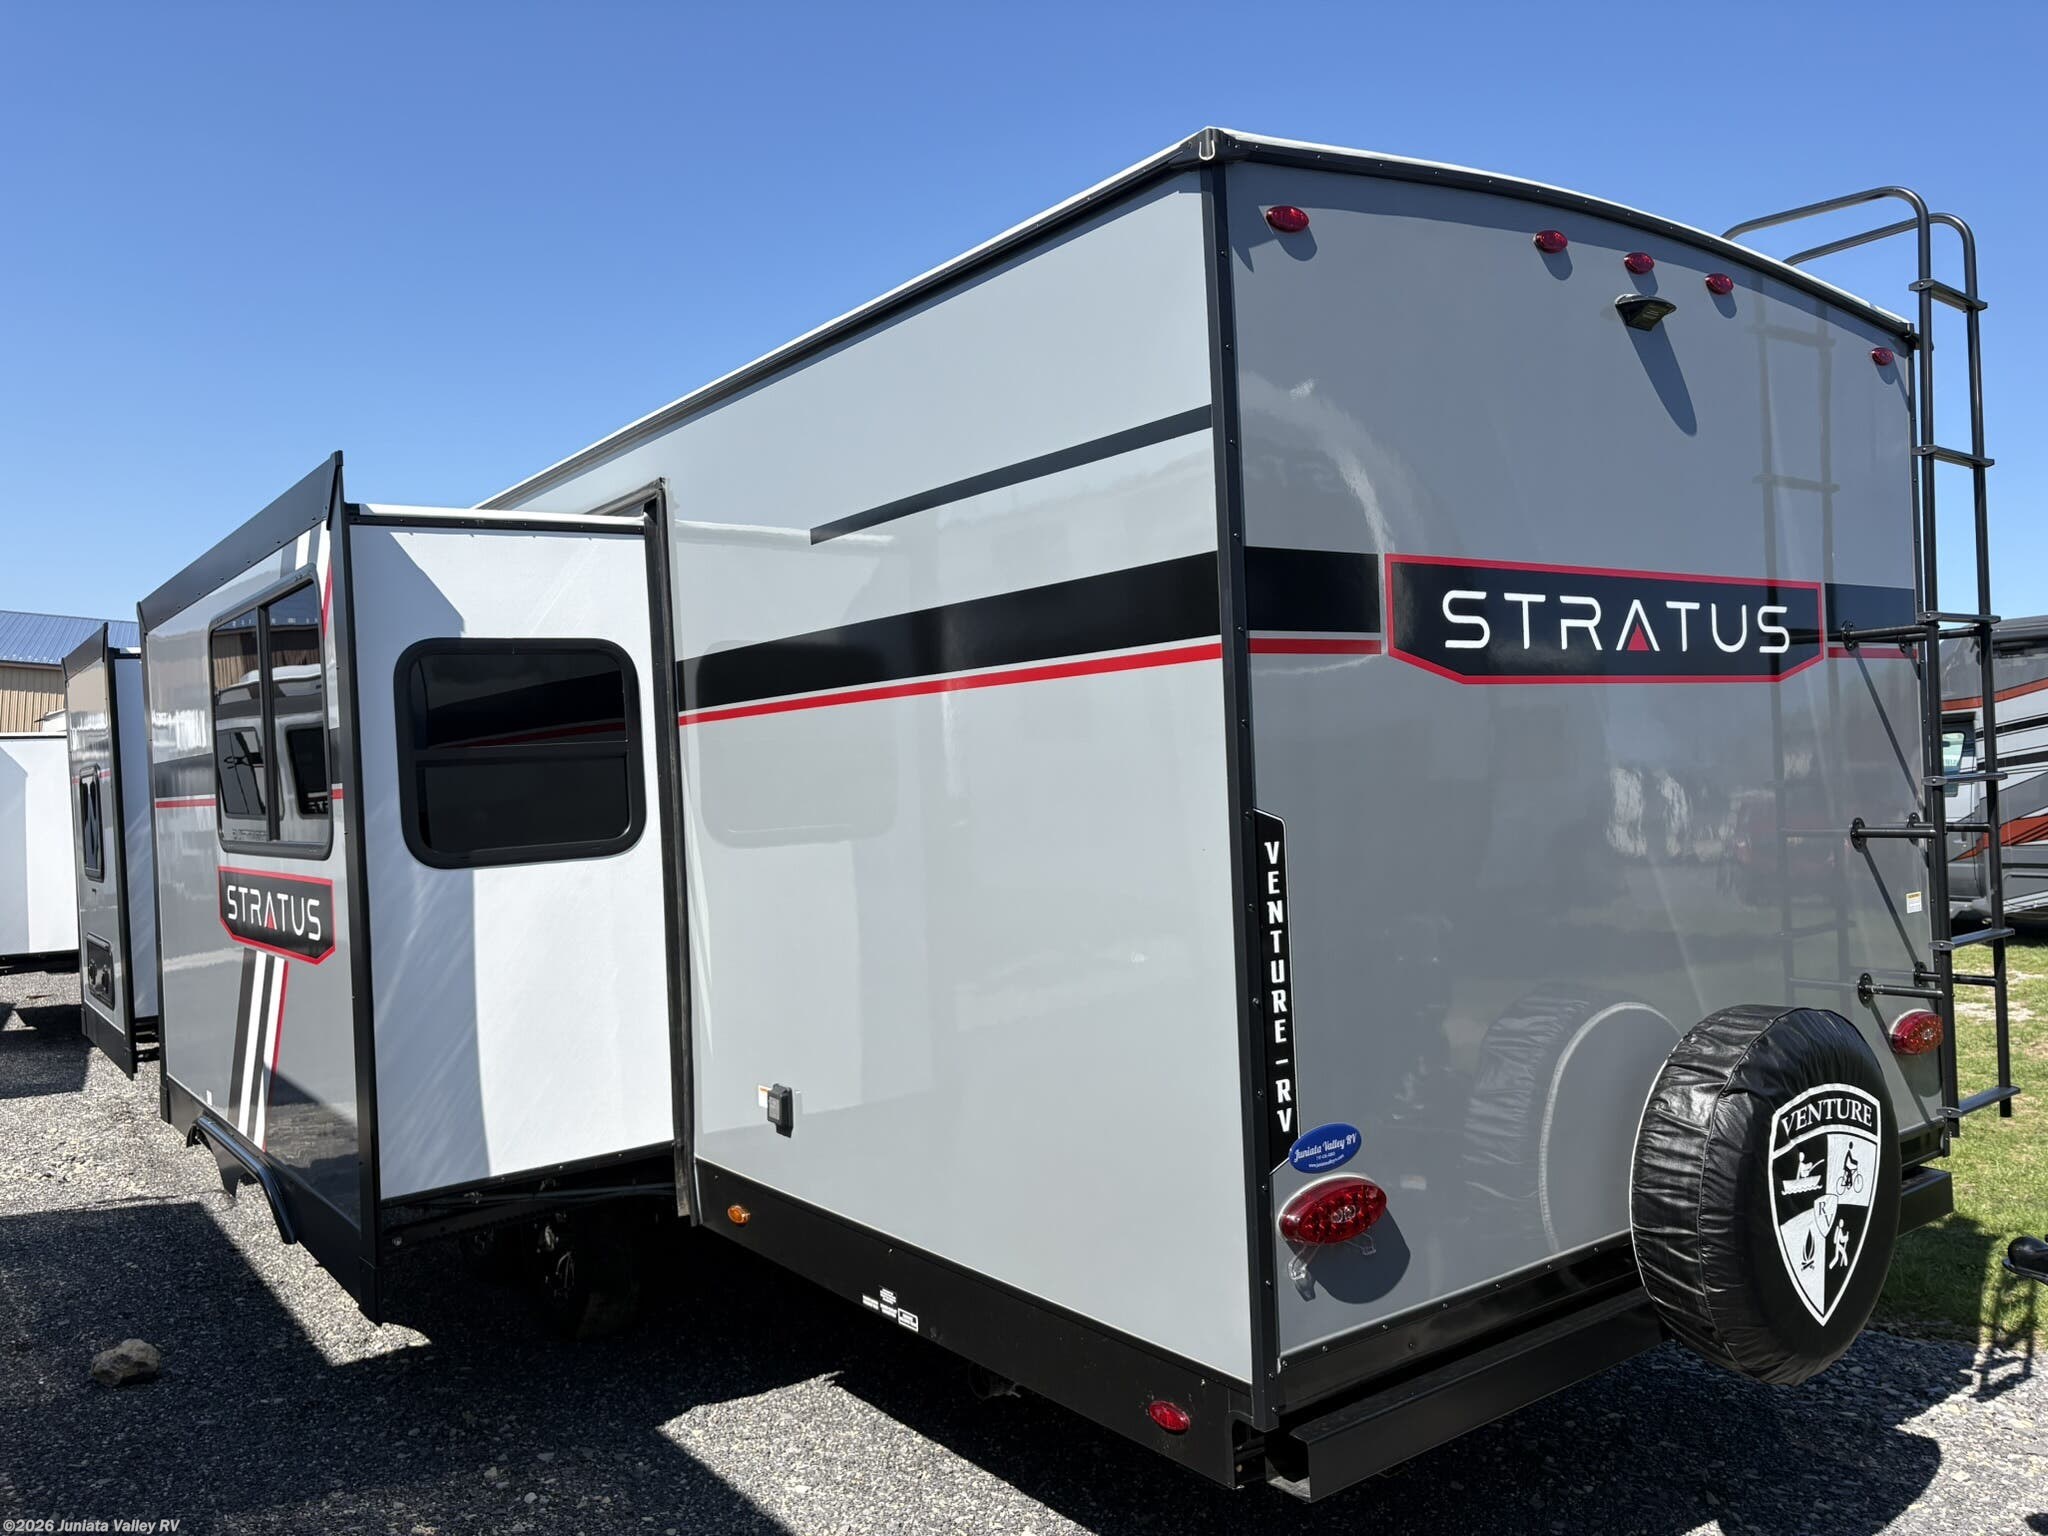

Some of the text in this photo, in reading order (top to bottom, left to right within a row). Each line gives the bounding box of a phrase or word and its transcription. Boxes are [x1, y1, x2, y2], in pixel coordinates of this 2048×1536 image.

[1442, 589, 1790, 653] STRATUS
[227, 886, 321, 940] STRATUS
[1781, 1099, 1873, 1134] VENTURE
[1293, 1144, 1322, 1163] Juniata
[1322, 1136, 1345, 1151] Valley
[1345, 1132, 1357, 1145] RV
